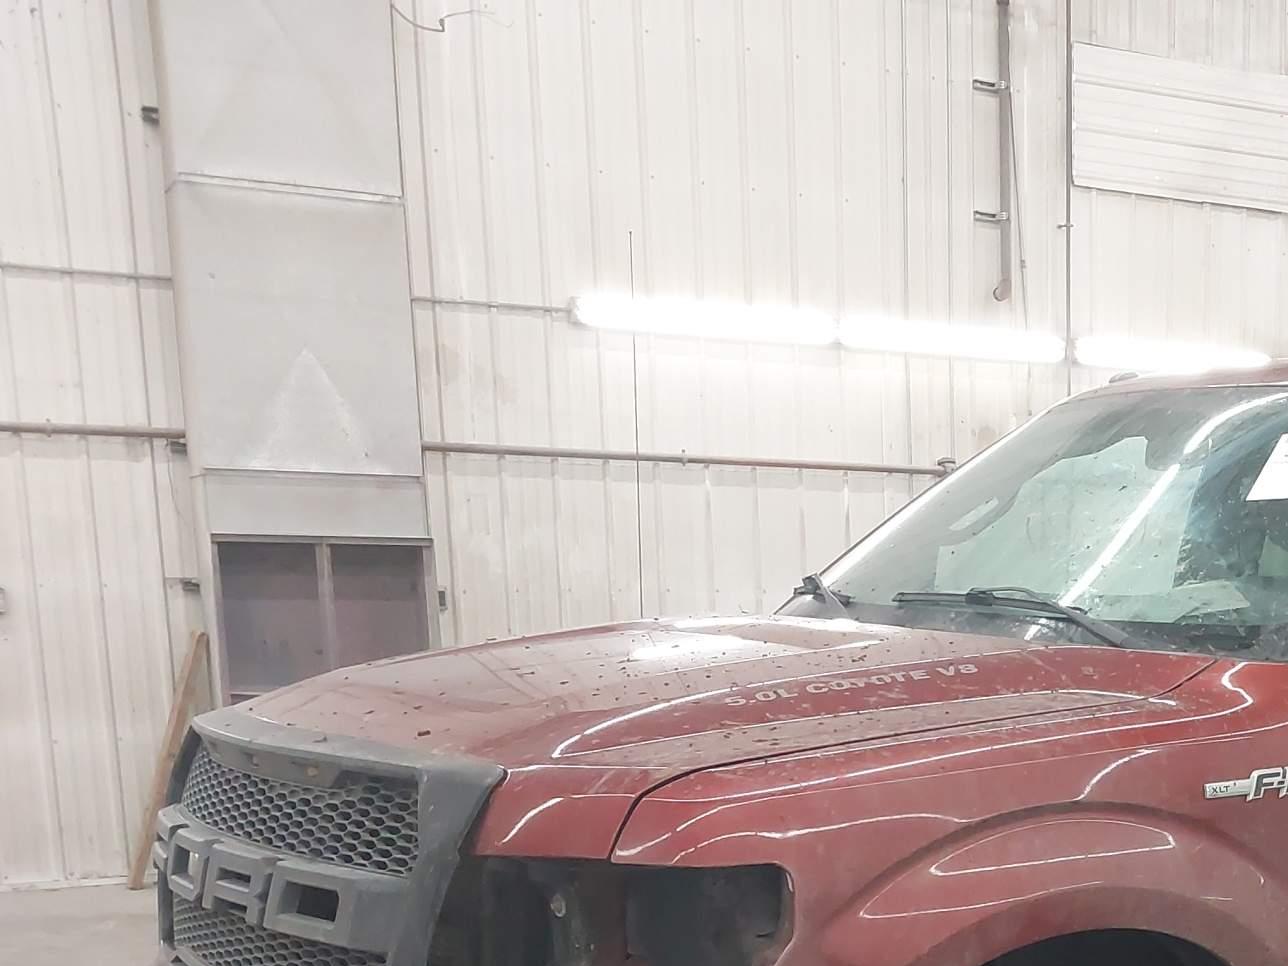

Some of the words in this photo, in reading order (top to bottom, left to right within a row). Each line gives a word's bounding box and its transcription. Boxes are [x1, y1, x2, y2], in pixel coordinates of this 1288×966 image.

[806, 668, 931, 694] COYOTE
[935, 663, 979, 677] V8
[1211, 785, 1232, 795] XLT
